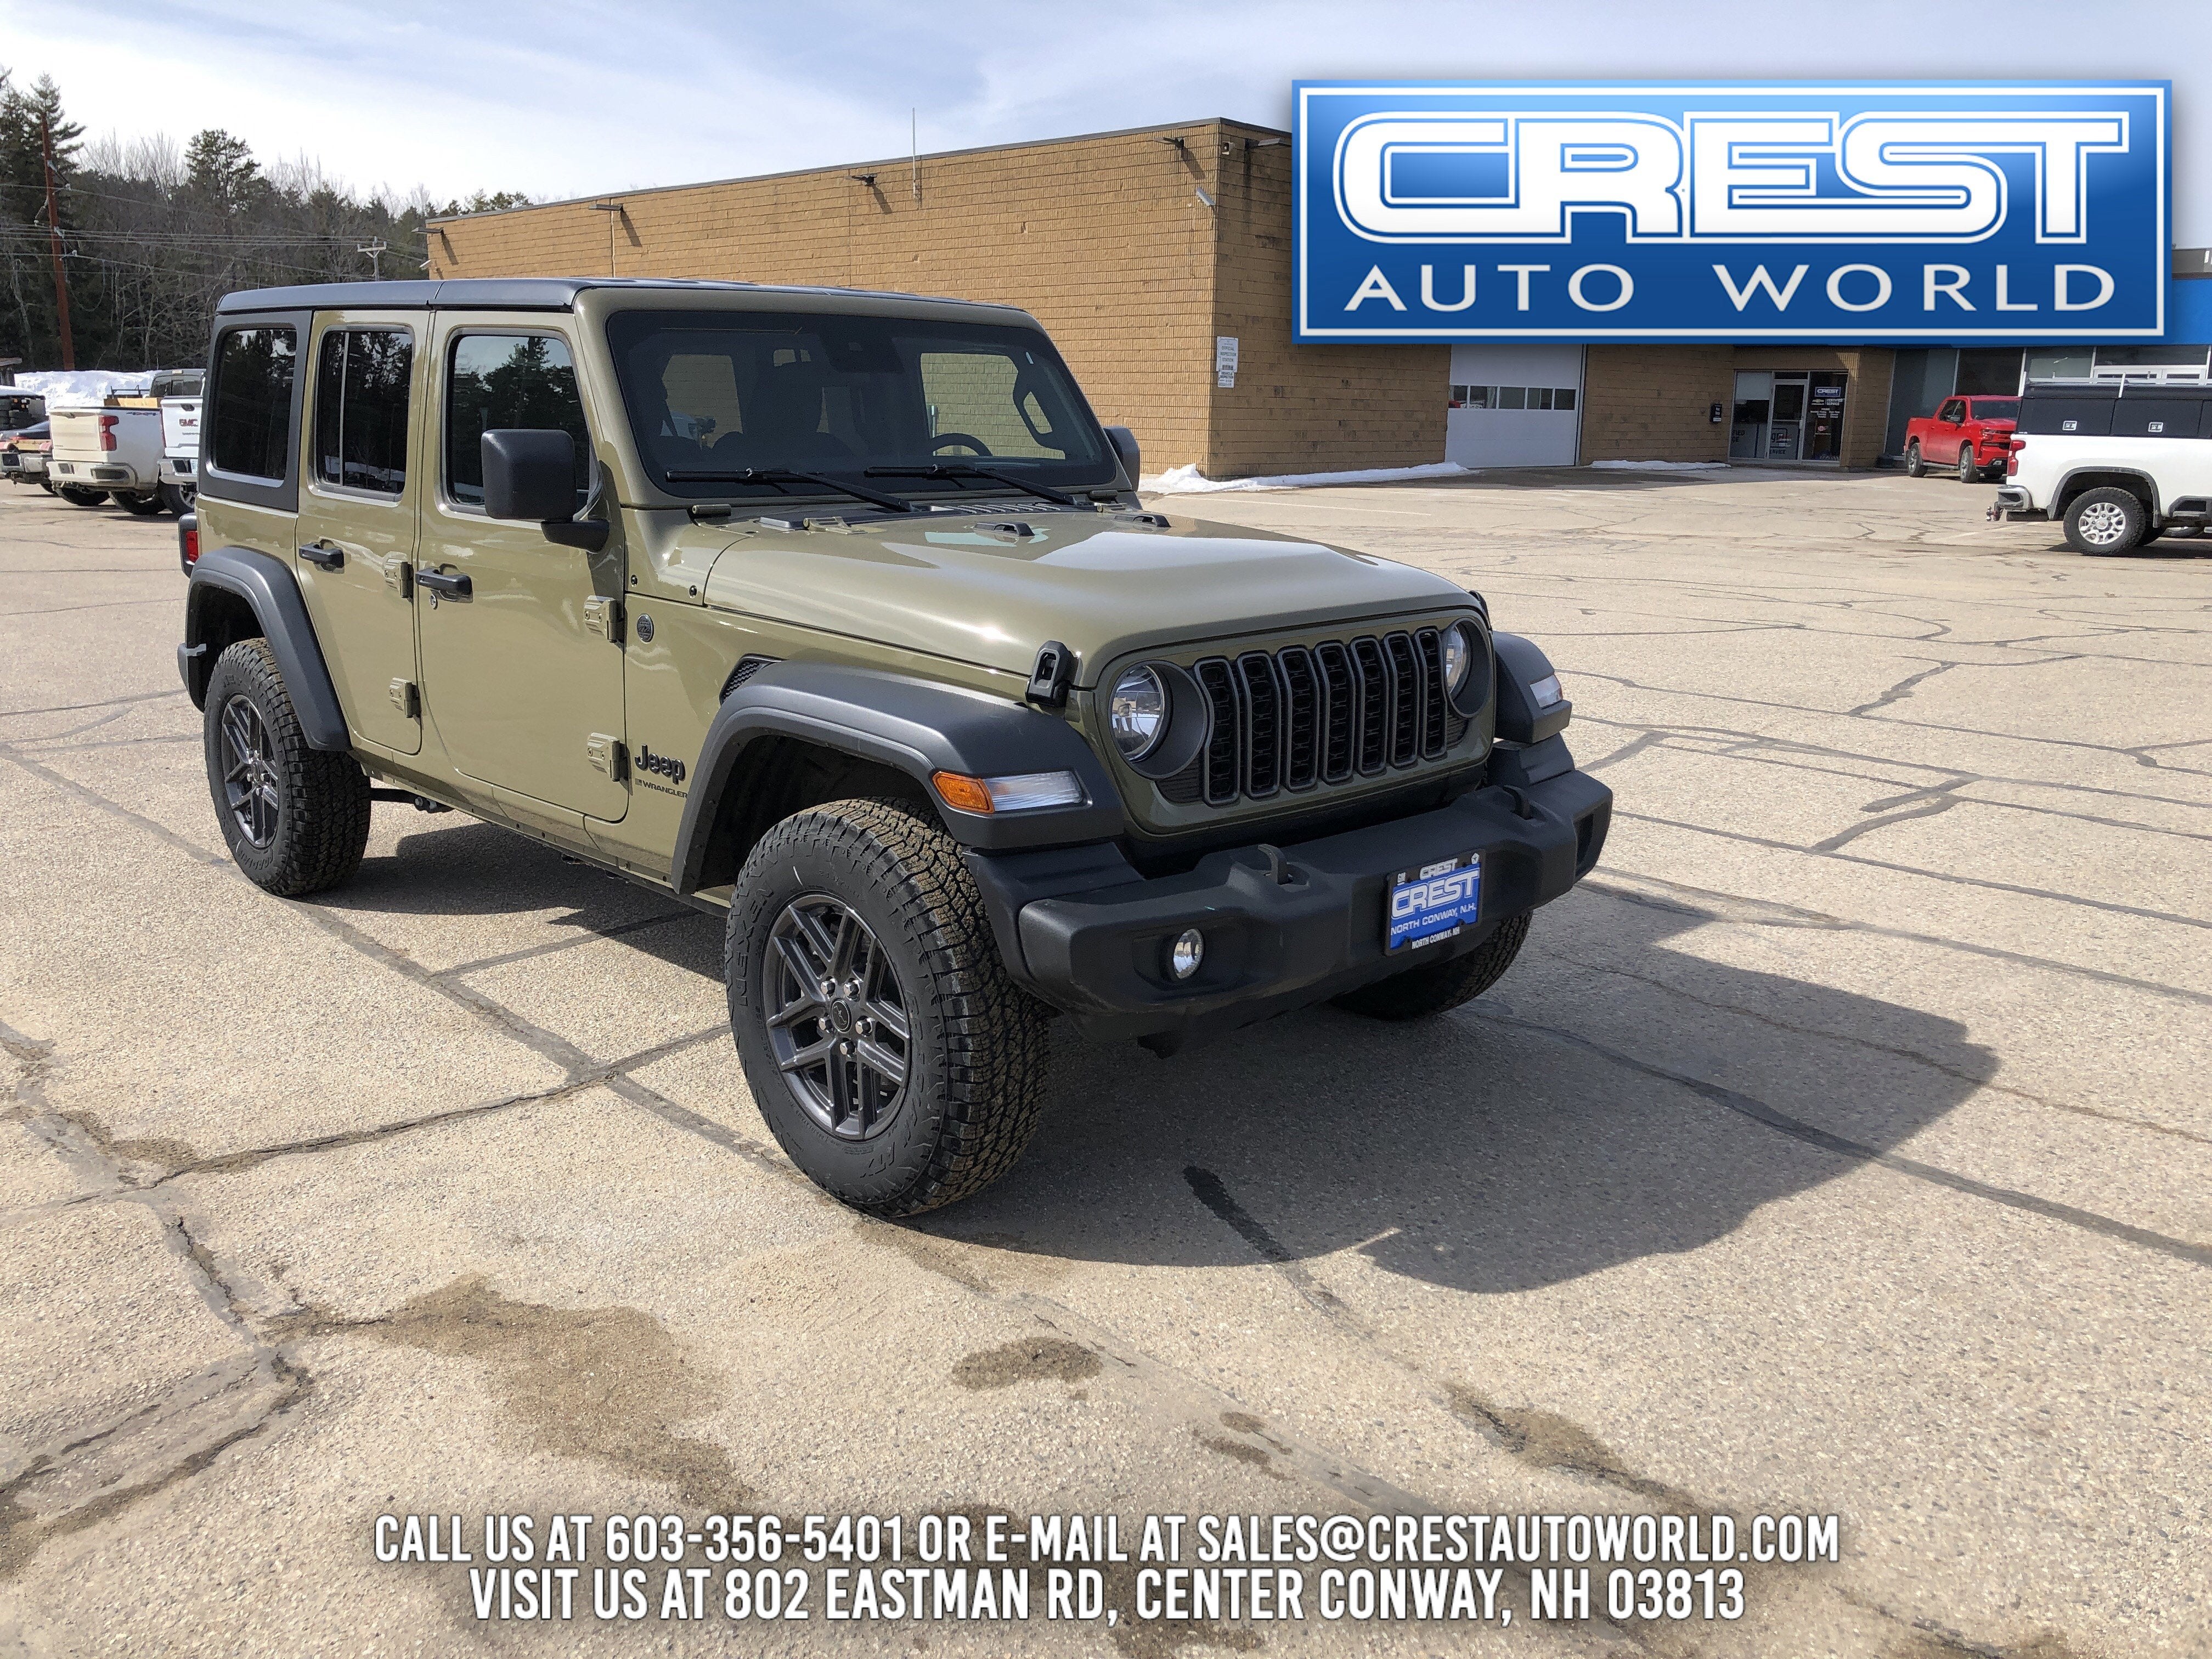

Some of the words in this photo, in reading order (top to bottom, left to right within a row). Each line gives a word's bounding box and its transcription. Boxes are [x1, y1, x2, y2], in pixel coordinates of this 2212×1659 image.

[179, 419, 199, 427] GMC
[634, 744, 686, 786] Jeep
[642, 780, 688, 799] WRANGLER
[1420, 858, 1458, 880] CREST
[1391, 867, 1480, 919] CREST
[1390, 918, 1420, 936] NORTH
[1422, 907, 1458, 926] CONWAY,
[1460, 902, 1477, 914] N.H.
[733, 887, 775, 1007] NEXEN
[1412, 936, 1430, 950] NORTH
[1452, 927, 1460, 936] NH
